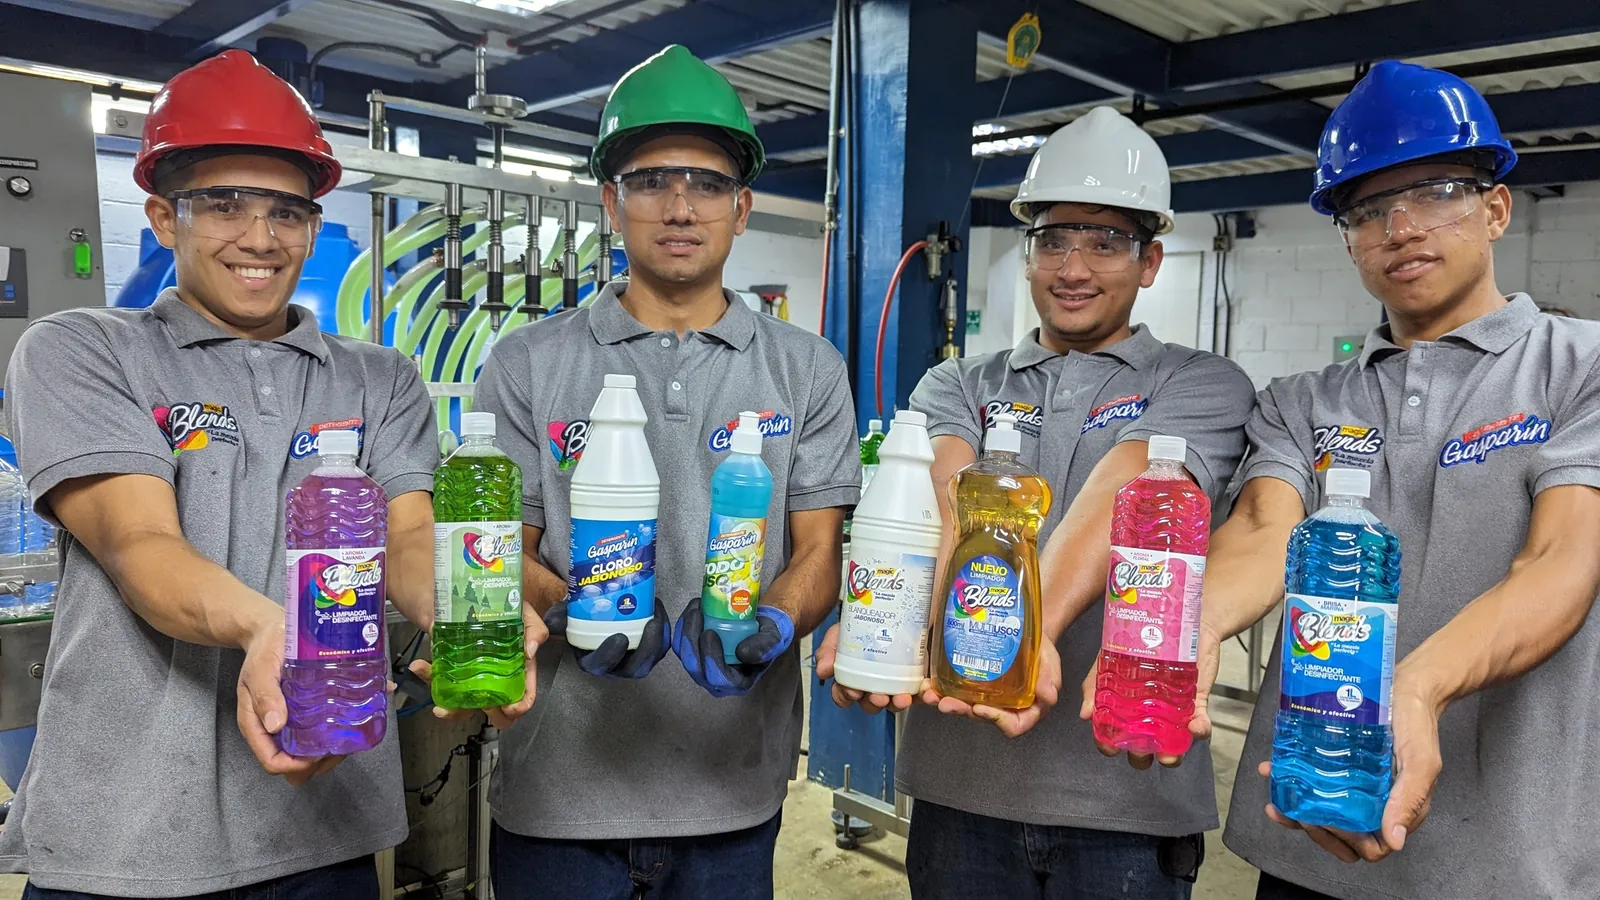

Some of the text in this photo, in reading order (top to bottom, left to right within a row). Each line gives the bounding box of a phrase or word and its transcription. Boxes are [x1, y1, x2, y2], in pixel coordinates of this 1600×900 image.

[985, 401, 1043, 428] Blends
[1082, 402, 1143, 433] Gaspar
[169, 404, 237, 441] Blends
[713, 416, 789, 449] Garín
[1443, 419, 1548, 464] Gasparín
[587, 536, 638, 558] Gasparín
[710, 532, 757, 554] Gasparín
[591, 557, 633, 575] CLORO
[877, 568, 895, 576] magic
[971, 562, 1008, 576] NUEVO
[578, 562, 643, 586] JABONOSO
[854, 567, 905, 591] Blends
[970, 572, 1006, 583] LIMPIADOR
[1116, 563, 1172, 588] Blends
[964, 585, 1016, 608] Blends
[1323, 600, 1342, 608] BRISA
[332, 610, 367, 618] LIMPIADOR
[332, 614, 378, 624] DESINFECTANTE
[848, 605, 896, 620] BLANQUEADOR
[854, 614, 885, 624] JABONOSO
[1116, 612, 1164, 625] DESINFECTANTE
[1117, 607, 1148, 617] LIMPIADOR
[1333, 615, 1355, 623] magic
[881, 628, 890, 637] 1L
[1147, 628, 1158, 637] 1L
[1299, 612, 1371, 641] Blends
[1303, 669, 1361, 683] DESINFECTANTE
[1304, 663, 1344, 675] LIMPIADOR
[1345, 688, 1357, 698] 1L
